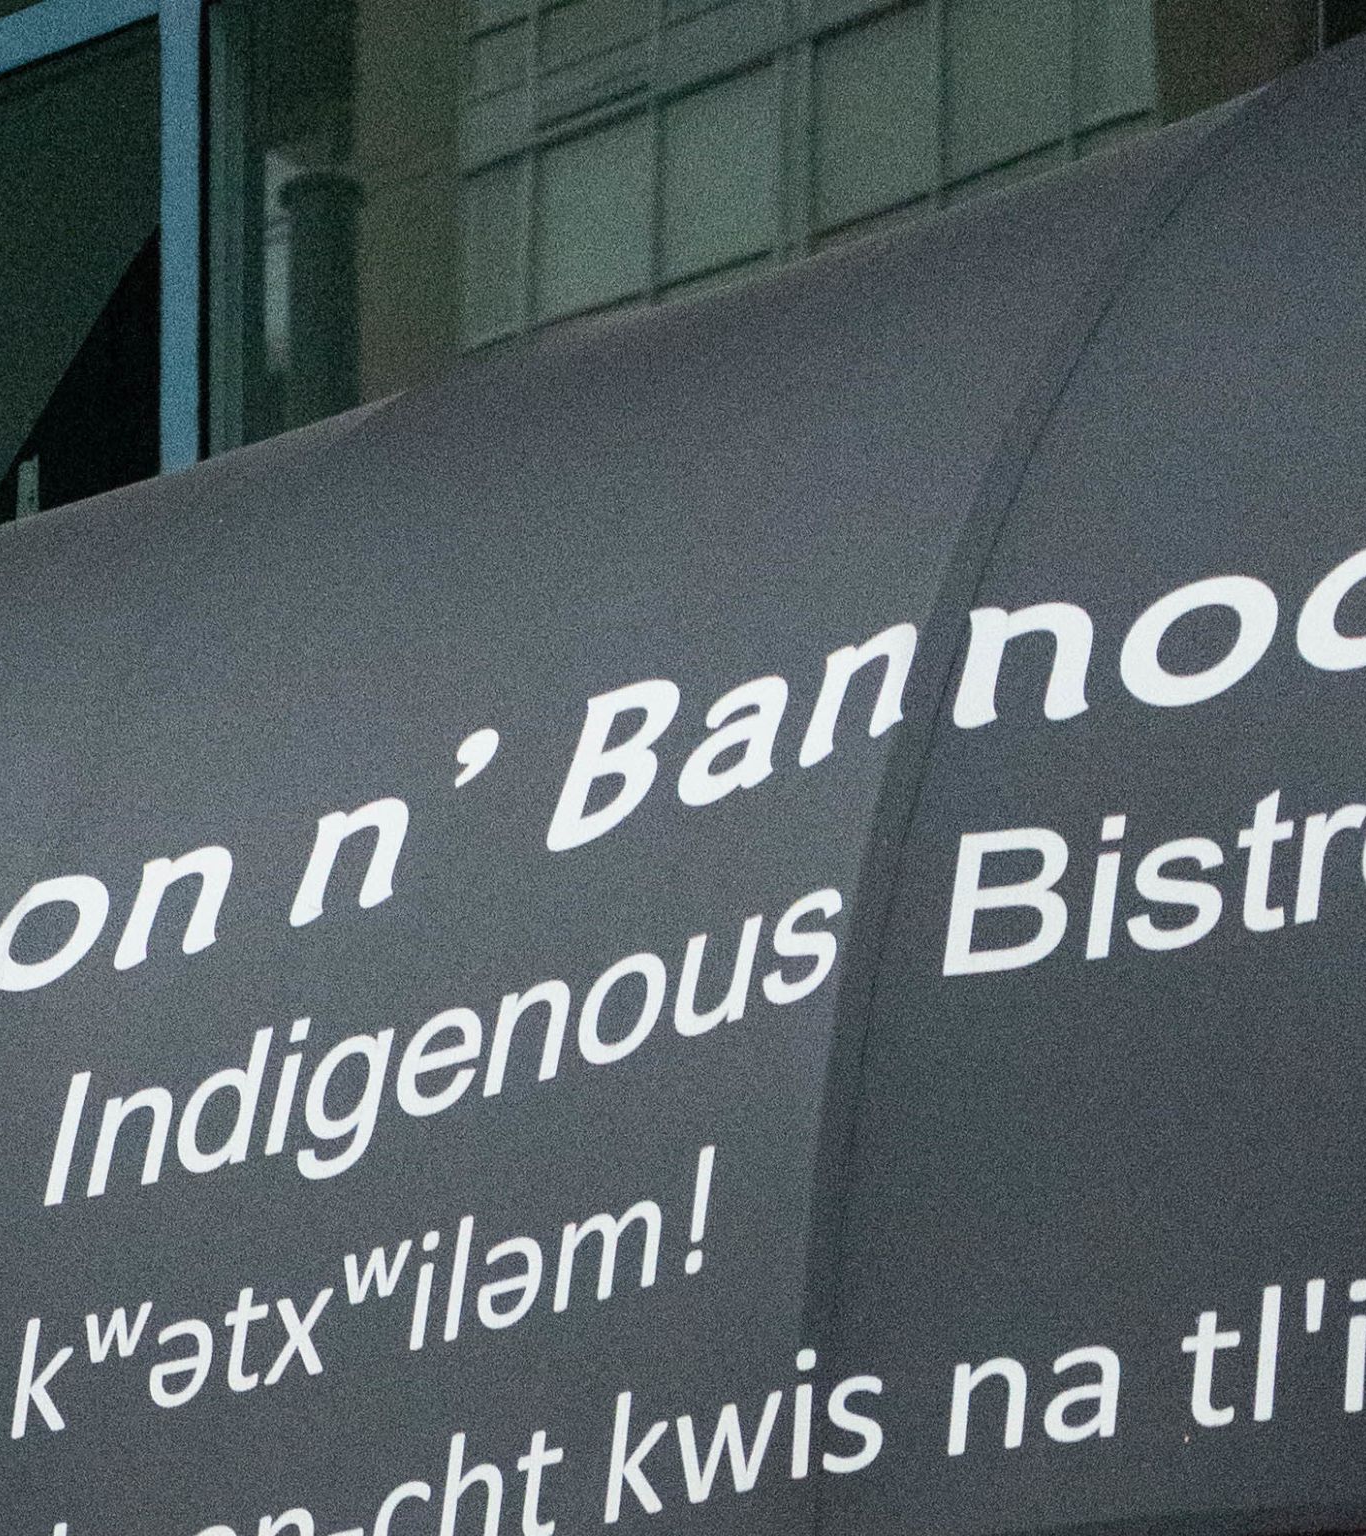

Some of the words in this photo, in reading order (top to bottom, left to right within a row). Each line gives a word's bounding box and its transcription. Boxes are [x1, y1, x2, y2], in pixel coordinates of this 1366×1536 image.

[43, 886, 843, 1207] Indigenous
[604, 1349, 883, 1524] kwis
[947, 1345, 1120, 1456] na
